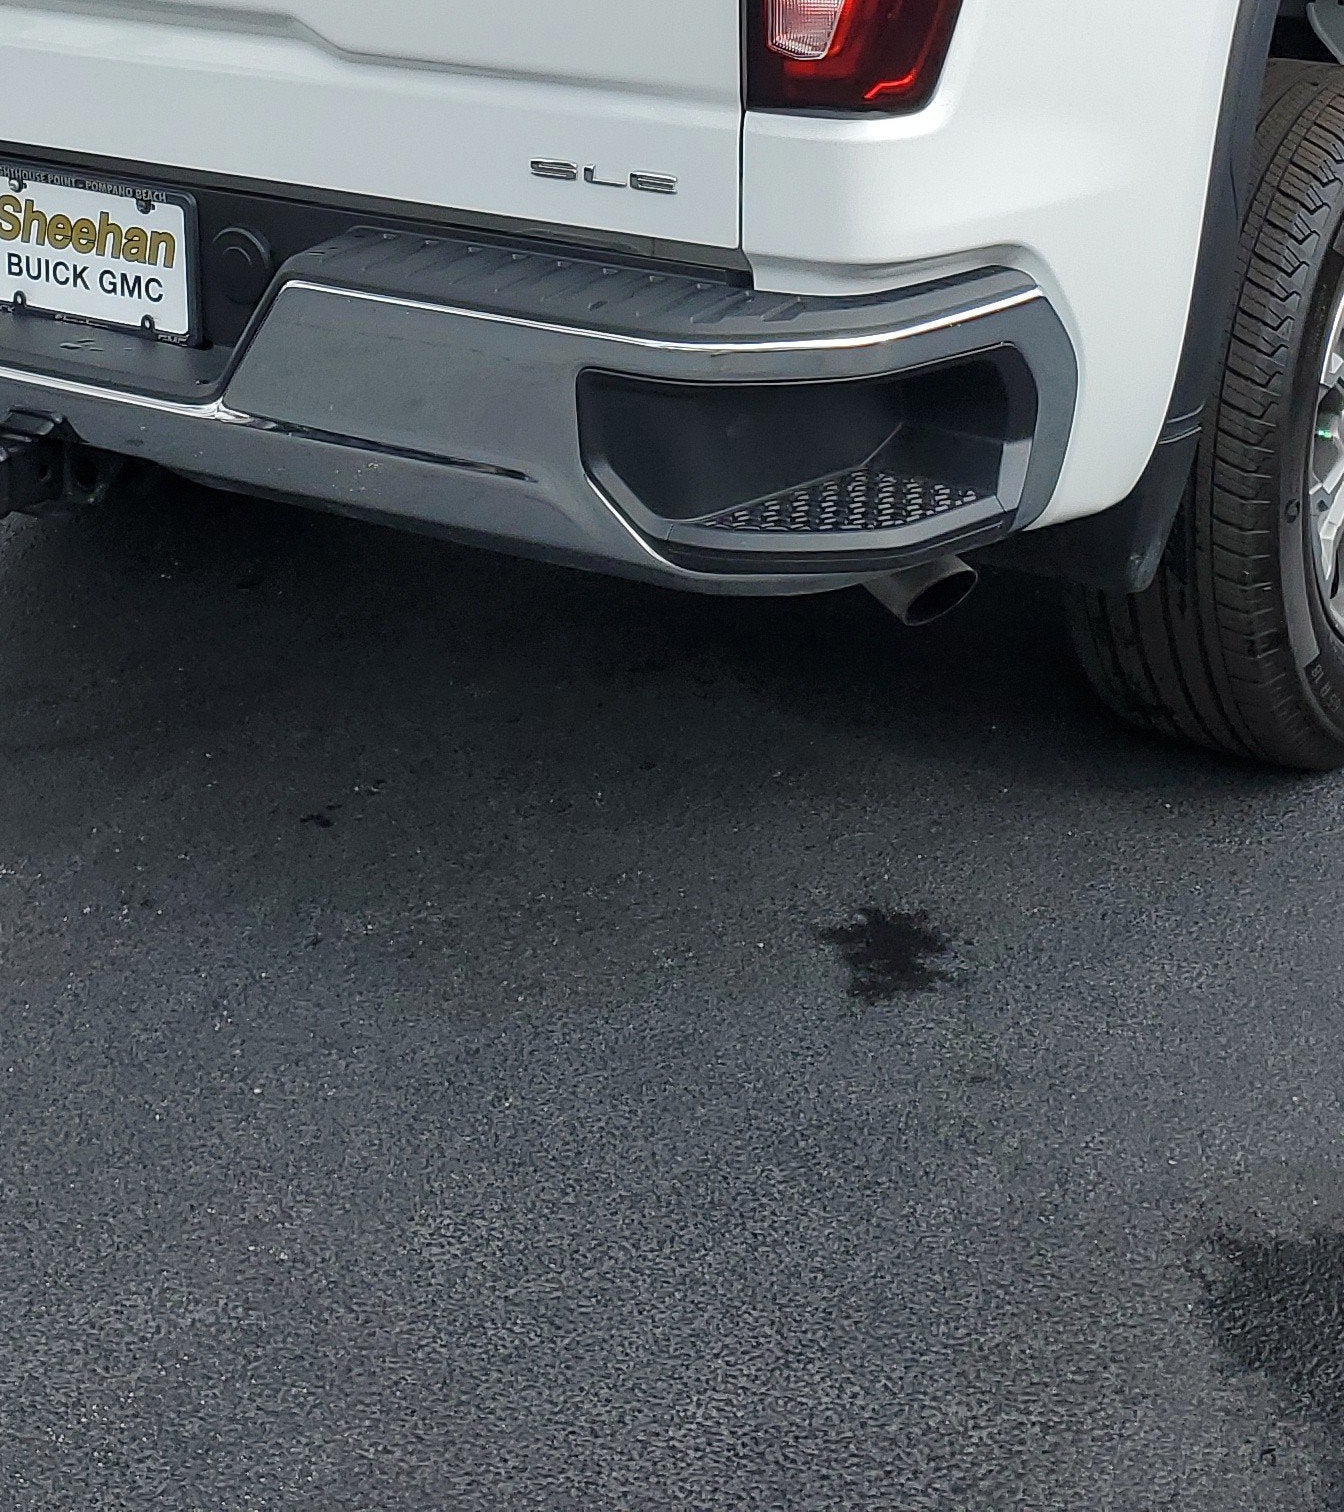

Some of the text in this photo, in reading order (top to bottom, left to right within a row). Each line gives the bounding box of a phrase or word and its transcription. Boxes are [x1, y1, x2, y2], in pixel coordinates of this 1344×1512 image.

[47, 173, 77, 189] POINT
[85, 180, 134, 199] POMPANO
[135, 188, 168, 204] BEACH
[529, 157, 678, 195] SLE
[7, 251, 164, 303] BUICK GMC
